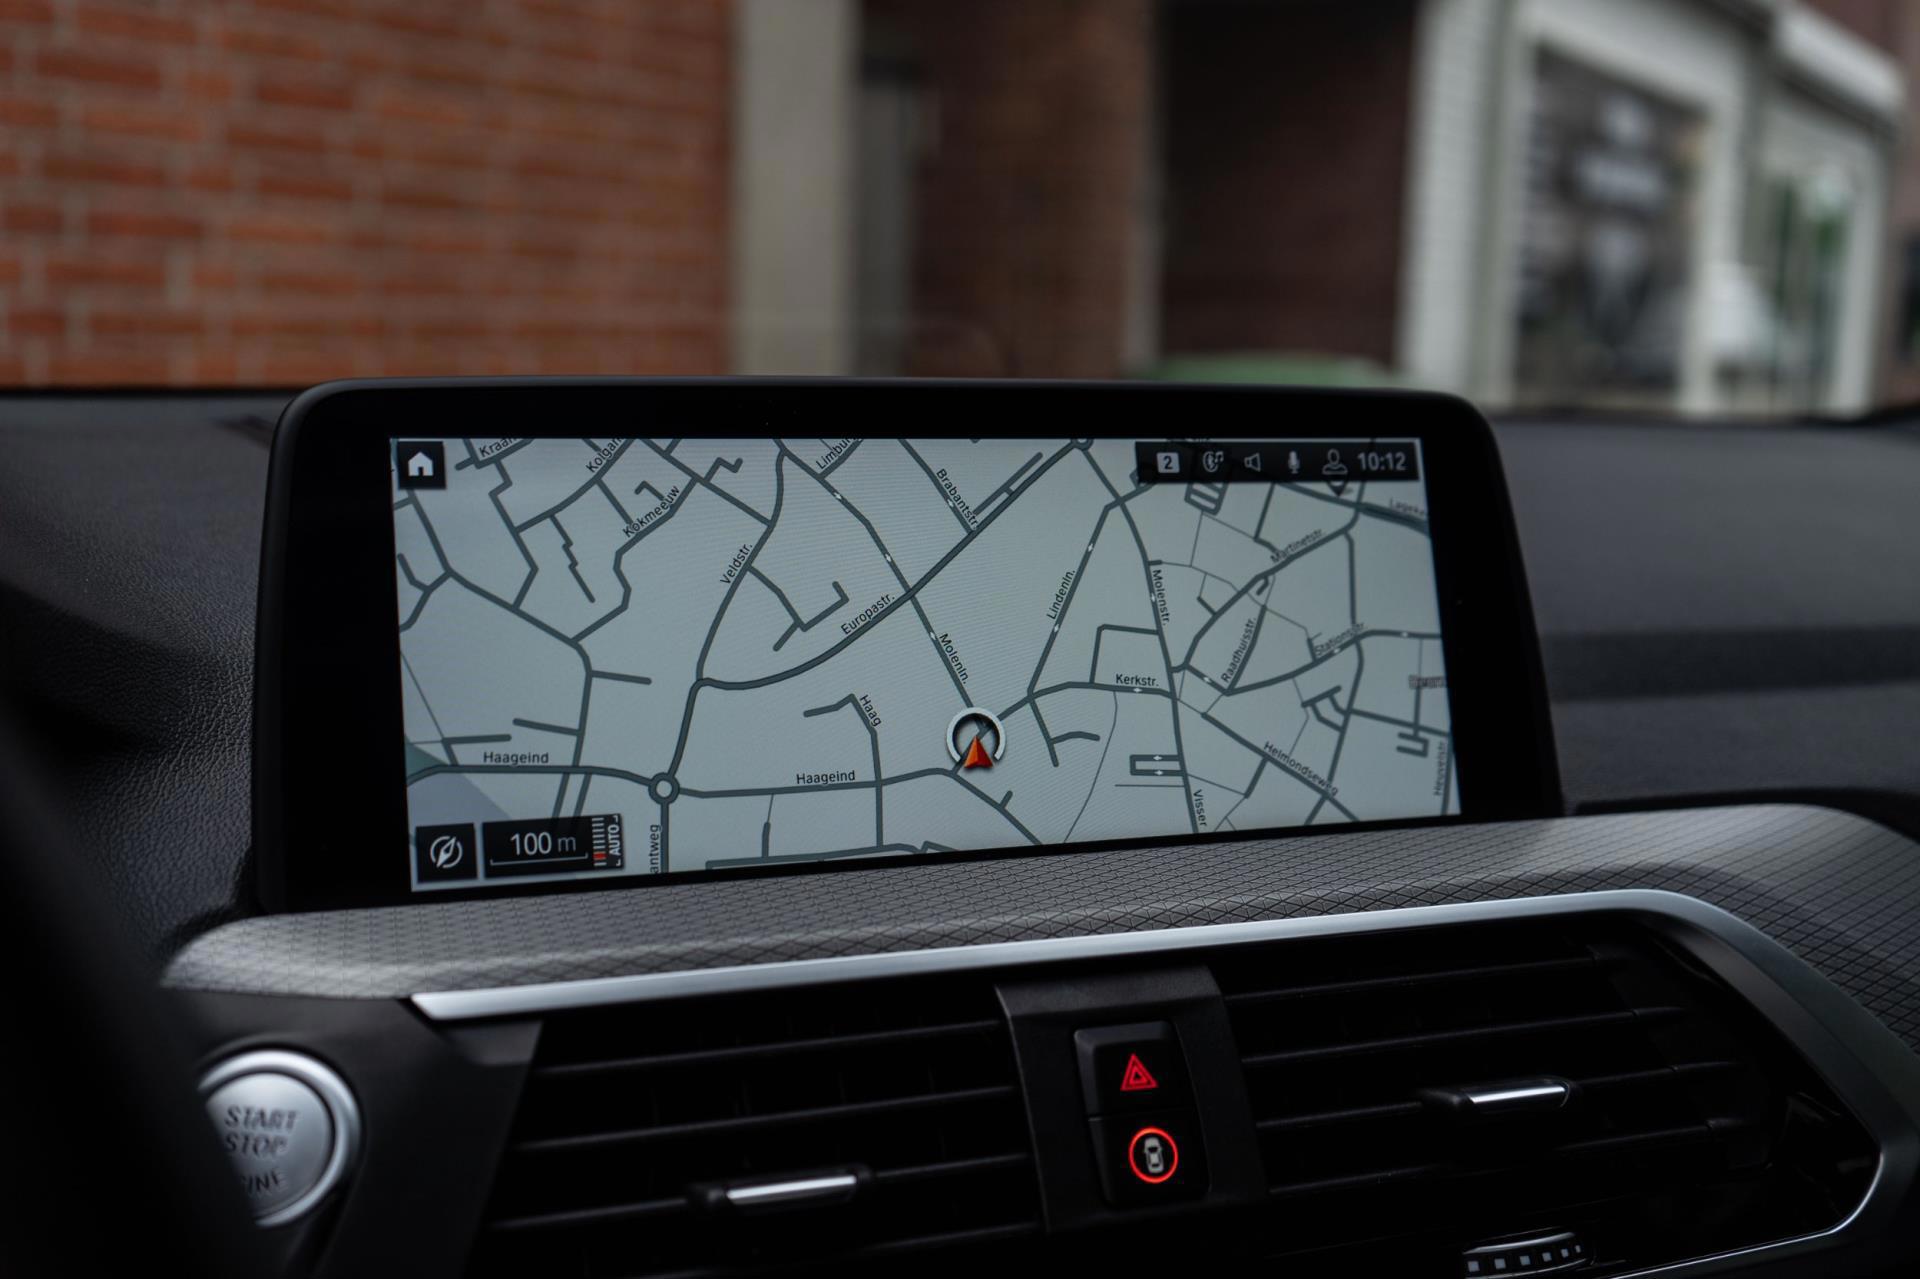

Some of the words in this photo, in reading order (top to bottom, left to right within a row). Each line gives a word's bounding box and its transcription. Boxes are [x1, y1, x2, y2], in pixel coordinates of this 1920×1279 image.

[1357, 452, 1406, 471] 10:12
[622, 485, 681, 539] Kokmeeuw
[936, 468, 980, 530] Brabantstr.
[720, 543, 753, 585] Veldstr.
[1046, 568, 1076, 620] Lindenln.
[1153, 569, 1171, 626] Molenstr.
[840, 593, 896, 635] Europastr.
[938, 633, 969, 684] Molenln.
[1221, 617, 1257, 683] Raadhuisstr.
[1115, 673, 1160, 687] Kerkstr.
[860, 694, 882, 727] Haag
[483, 751, 549, 766] Haageind
[796, 770, 856, 785] Haageind
[1264, 740, 1339, 796] Helmondseweg
[1193, 789, 1207, 827] Visser
[510, 831, 552, 856] 100
[557, 836, 577, 852] m
[608, 824, 620, 857] AUTO
[225, 1105, 299, 1131] START
[225, 1132, 288, 1157] STOP
